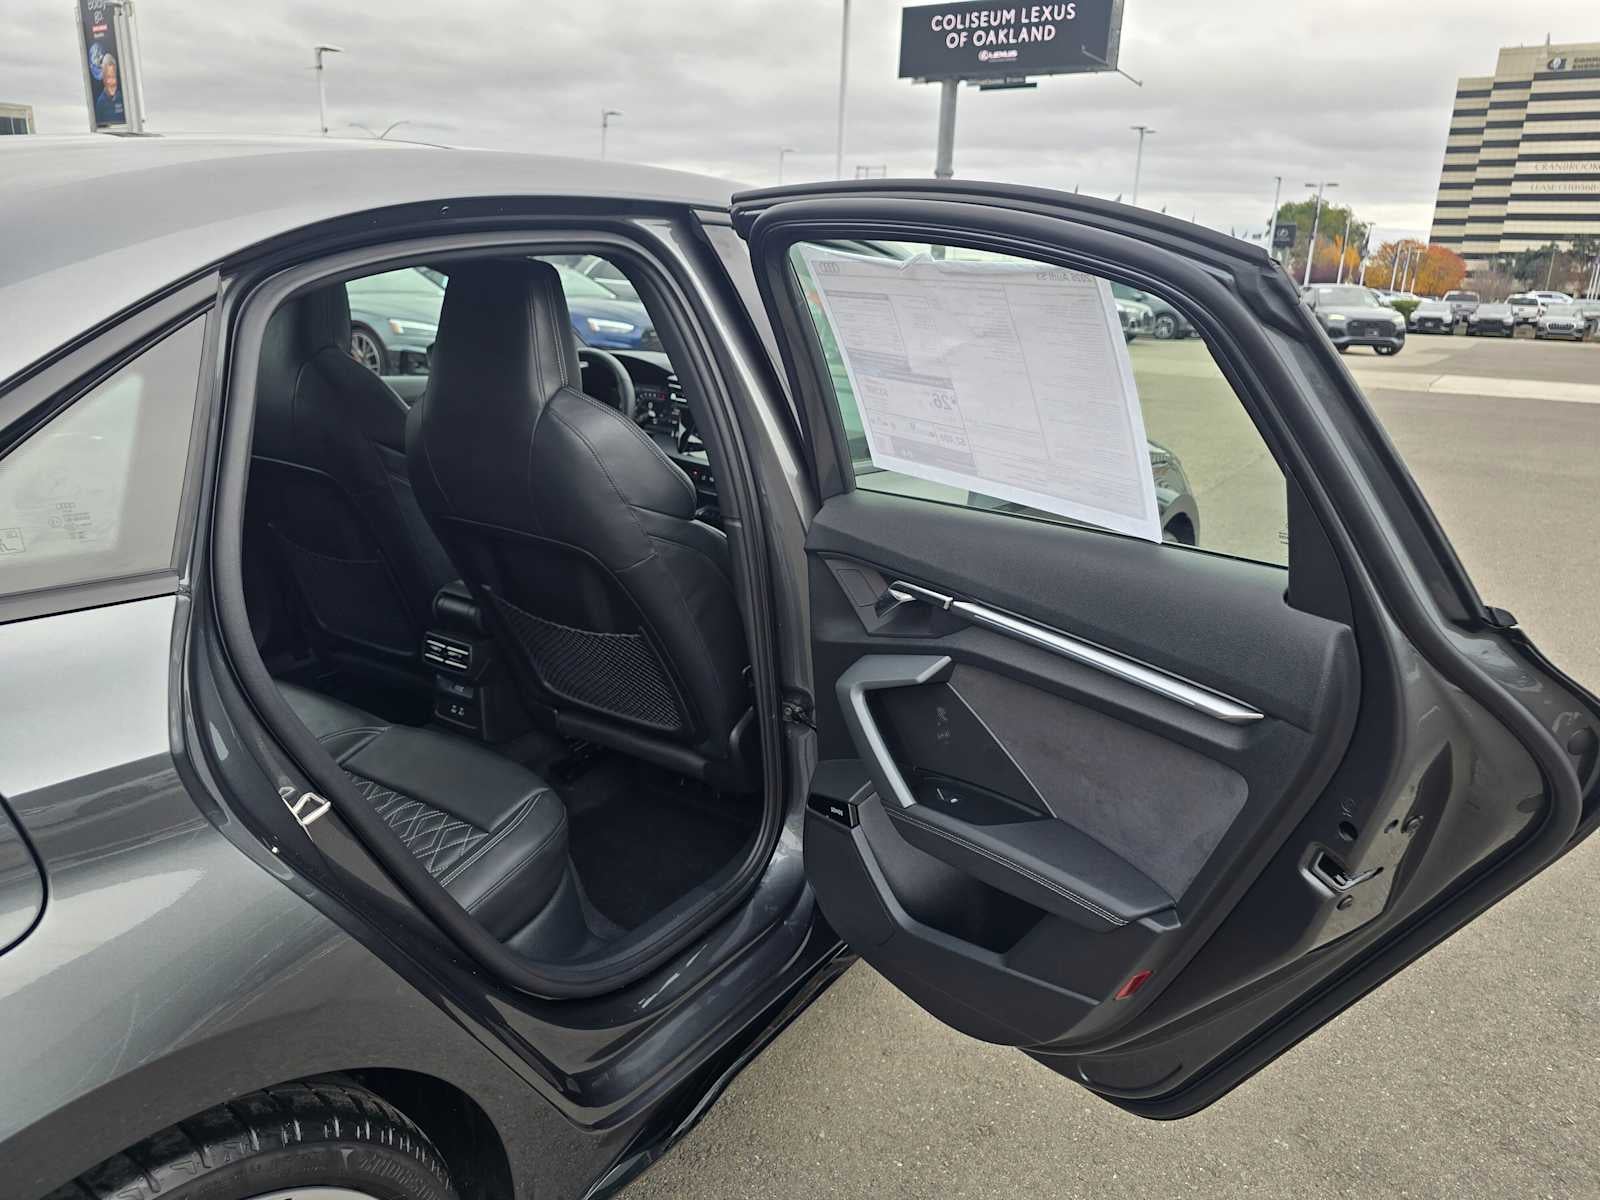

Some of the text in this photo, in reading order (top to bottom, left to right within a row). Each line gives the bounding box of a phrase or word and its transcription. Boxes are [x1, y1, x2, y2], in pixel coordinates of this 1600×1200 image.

[931, 3, 1076, 32] COLISEUM LEXUS
[945, 24, 1056, 49] OF OAKLAND
